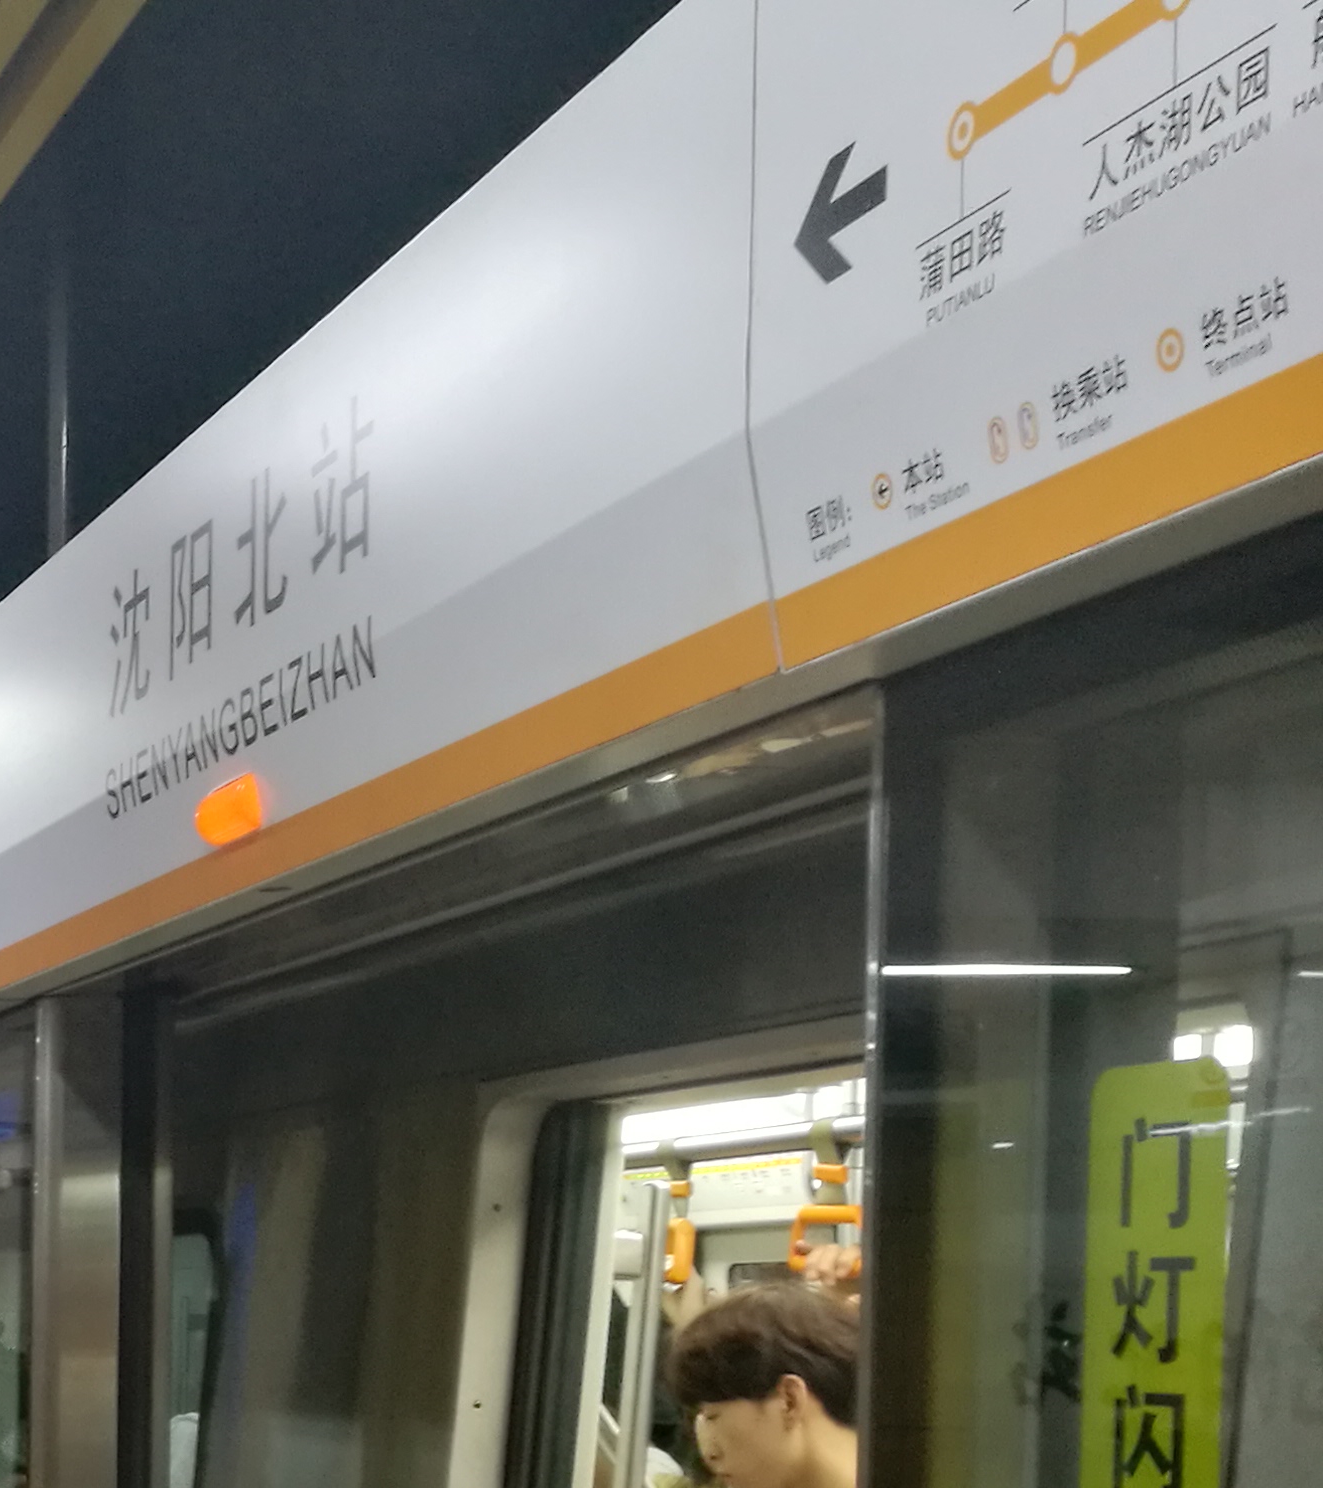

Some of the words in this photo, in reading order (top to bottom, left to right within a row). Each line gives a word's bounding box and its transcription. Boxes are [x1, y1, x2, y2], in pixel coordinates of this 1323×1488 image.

[1089, 46, 1270, 201] 人杰湖公园
[1083, 112, 1271, 237] RENJIEHUGONGYUAN
[919, 210, 1005, 301] 蒲田路
[925, 272, 995, 327] PUTIANLU
[1201, 276, 1288, 350] 终点站
[1051, 354, 1129, 423] 换乘站
[1204, 333, 1272, 377] Terminal
[1056, 414, 1113, 450] Transfer
[902, 448, 945, 493] 本站
[110, 396, 375, 718] 沈阳北站
[813, 532, 851, 562] Legend
[105, 615, 377, 820] SHENYANGBEIZHAN
